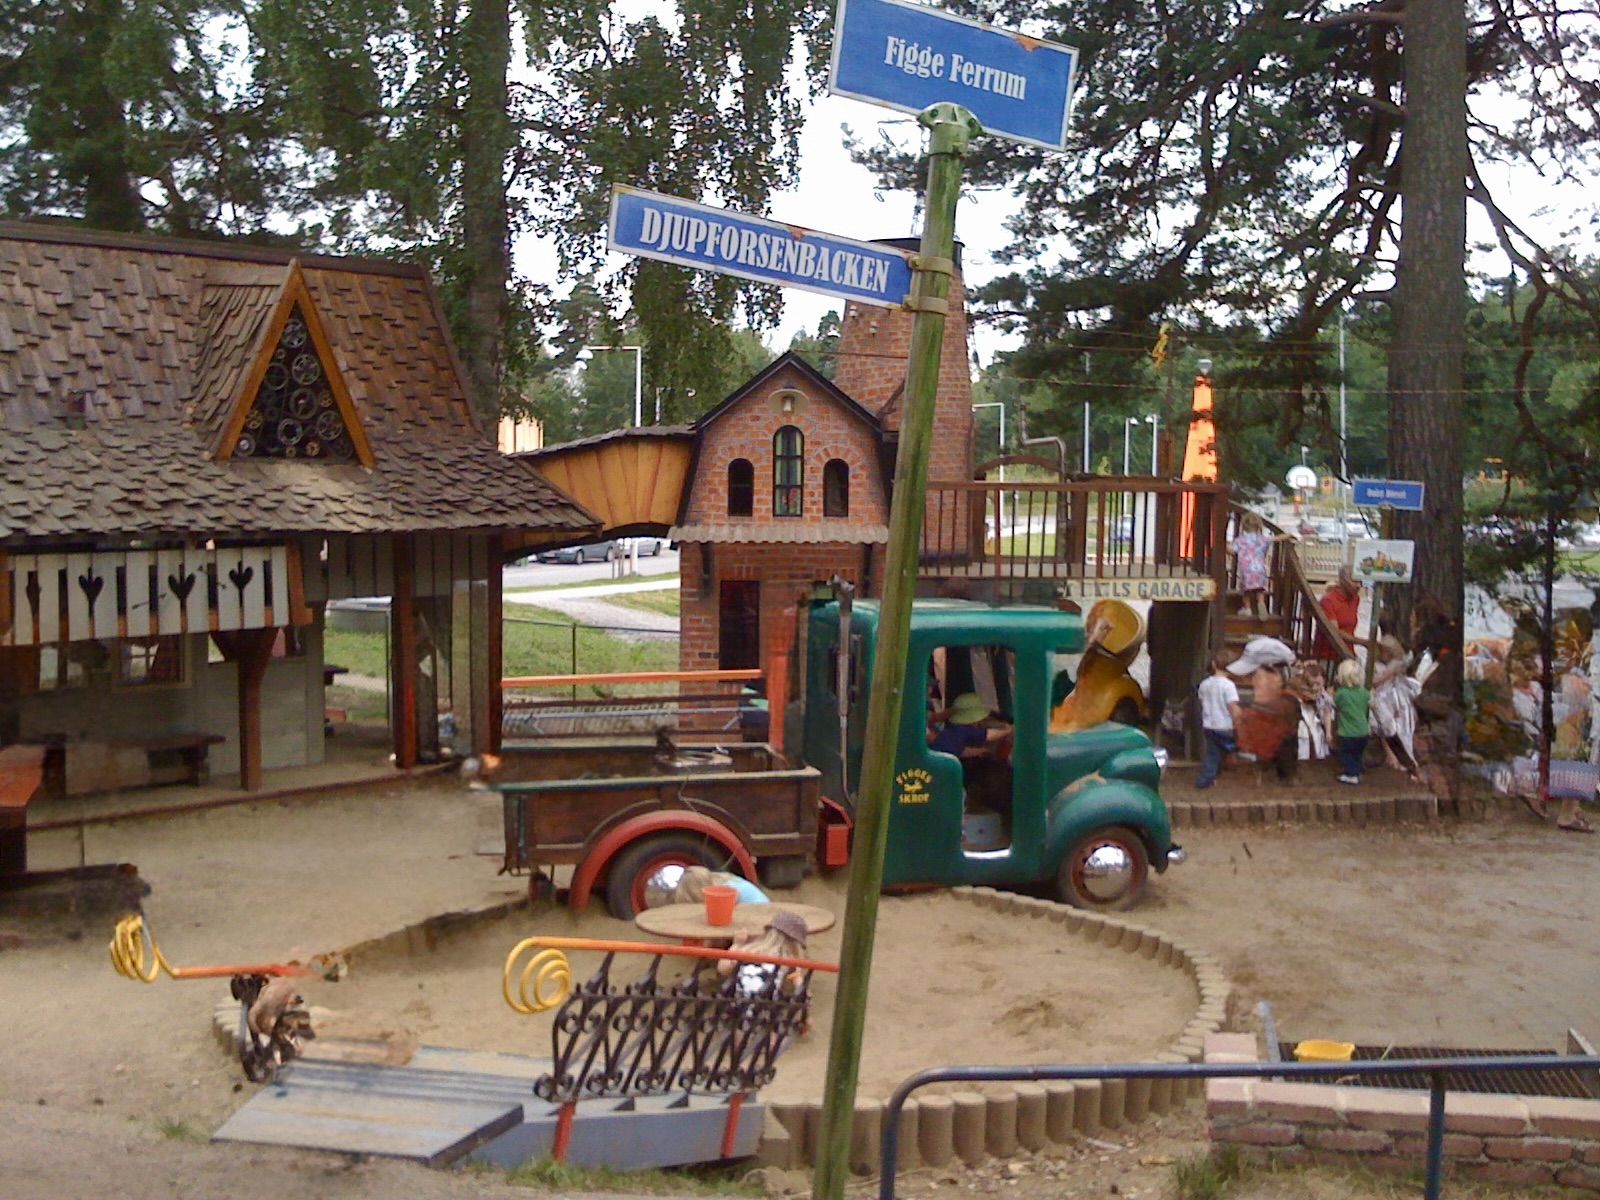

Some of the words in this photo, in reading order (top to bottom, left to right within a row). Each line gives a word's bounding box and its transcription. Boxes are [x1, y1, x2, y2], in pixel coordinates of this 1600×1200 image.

[884, 35, 945, 79] Figge
[948, 53, 1027, 100] Ferrum
[639, 207, 891, 293] DJUPFORSENBACKEN
[1137, 582, 1206, 598] GARAGE
